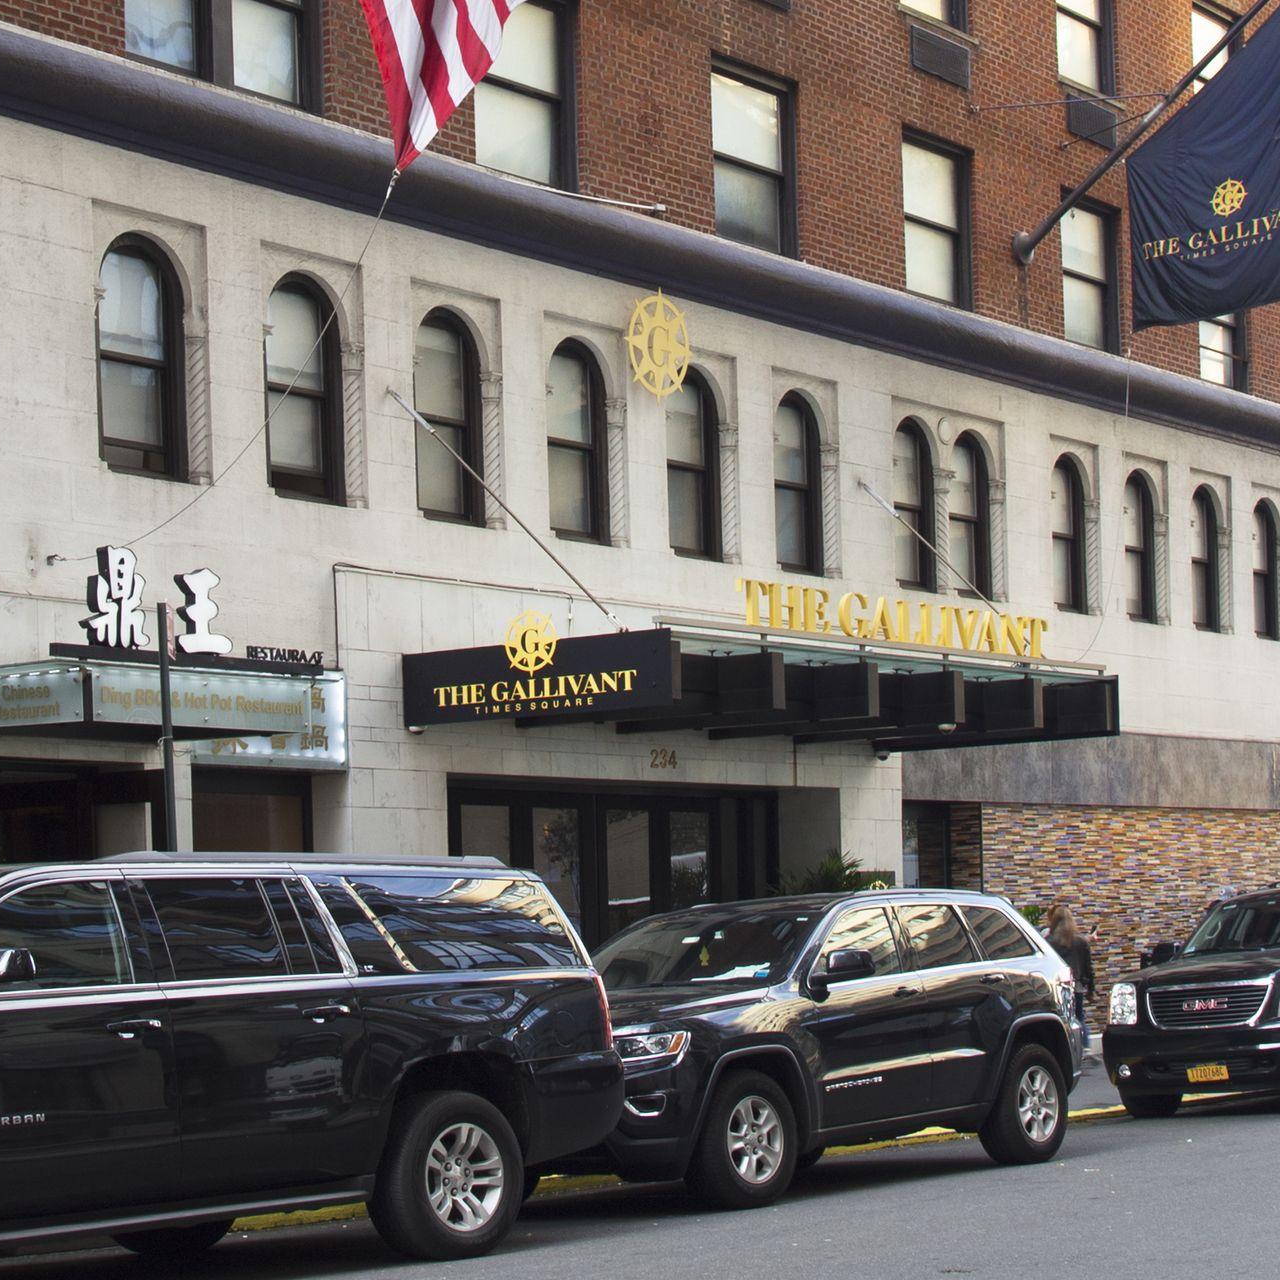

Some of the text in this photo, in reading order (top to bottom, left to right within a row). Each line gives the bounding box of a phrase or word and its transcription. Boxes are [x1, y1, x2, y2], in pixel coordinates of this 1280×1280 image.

[1142, 237, 1181, 261] THE
[1180, 249, 1216, 261] TIMES
[735, 577, 1049, 660] THE GALLIVANT
[0, 685, 51, 702] Chinese
[433, 669, 638, 708] THE GALLIVANT
[100, 685, 132, 710] Ding
[134, 687, 163, 708] BBQ
[184, 690, 208, 710] Hot
[211, 693, 232, 711] Pot
[236, 696, 305, 717] Restaurant
[474, 697, 594, 715] TIMES SQUARE
[650, 749, 678, 769] 234
[1182, 997, 1229, 1012] GMC
